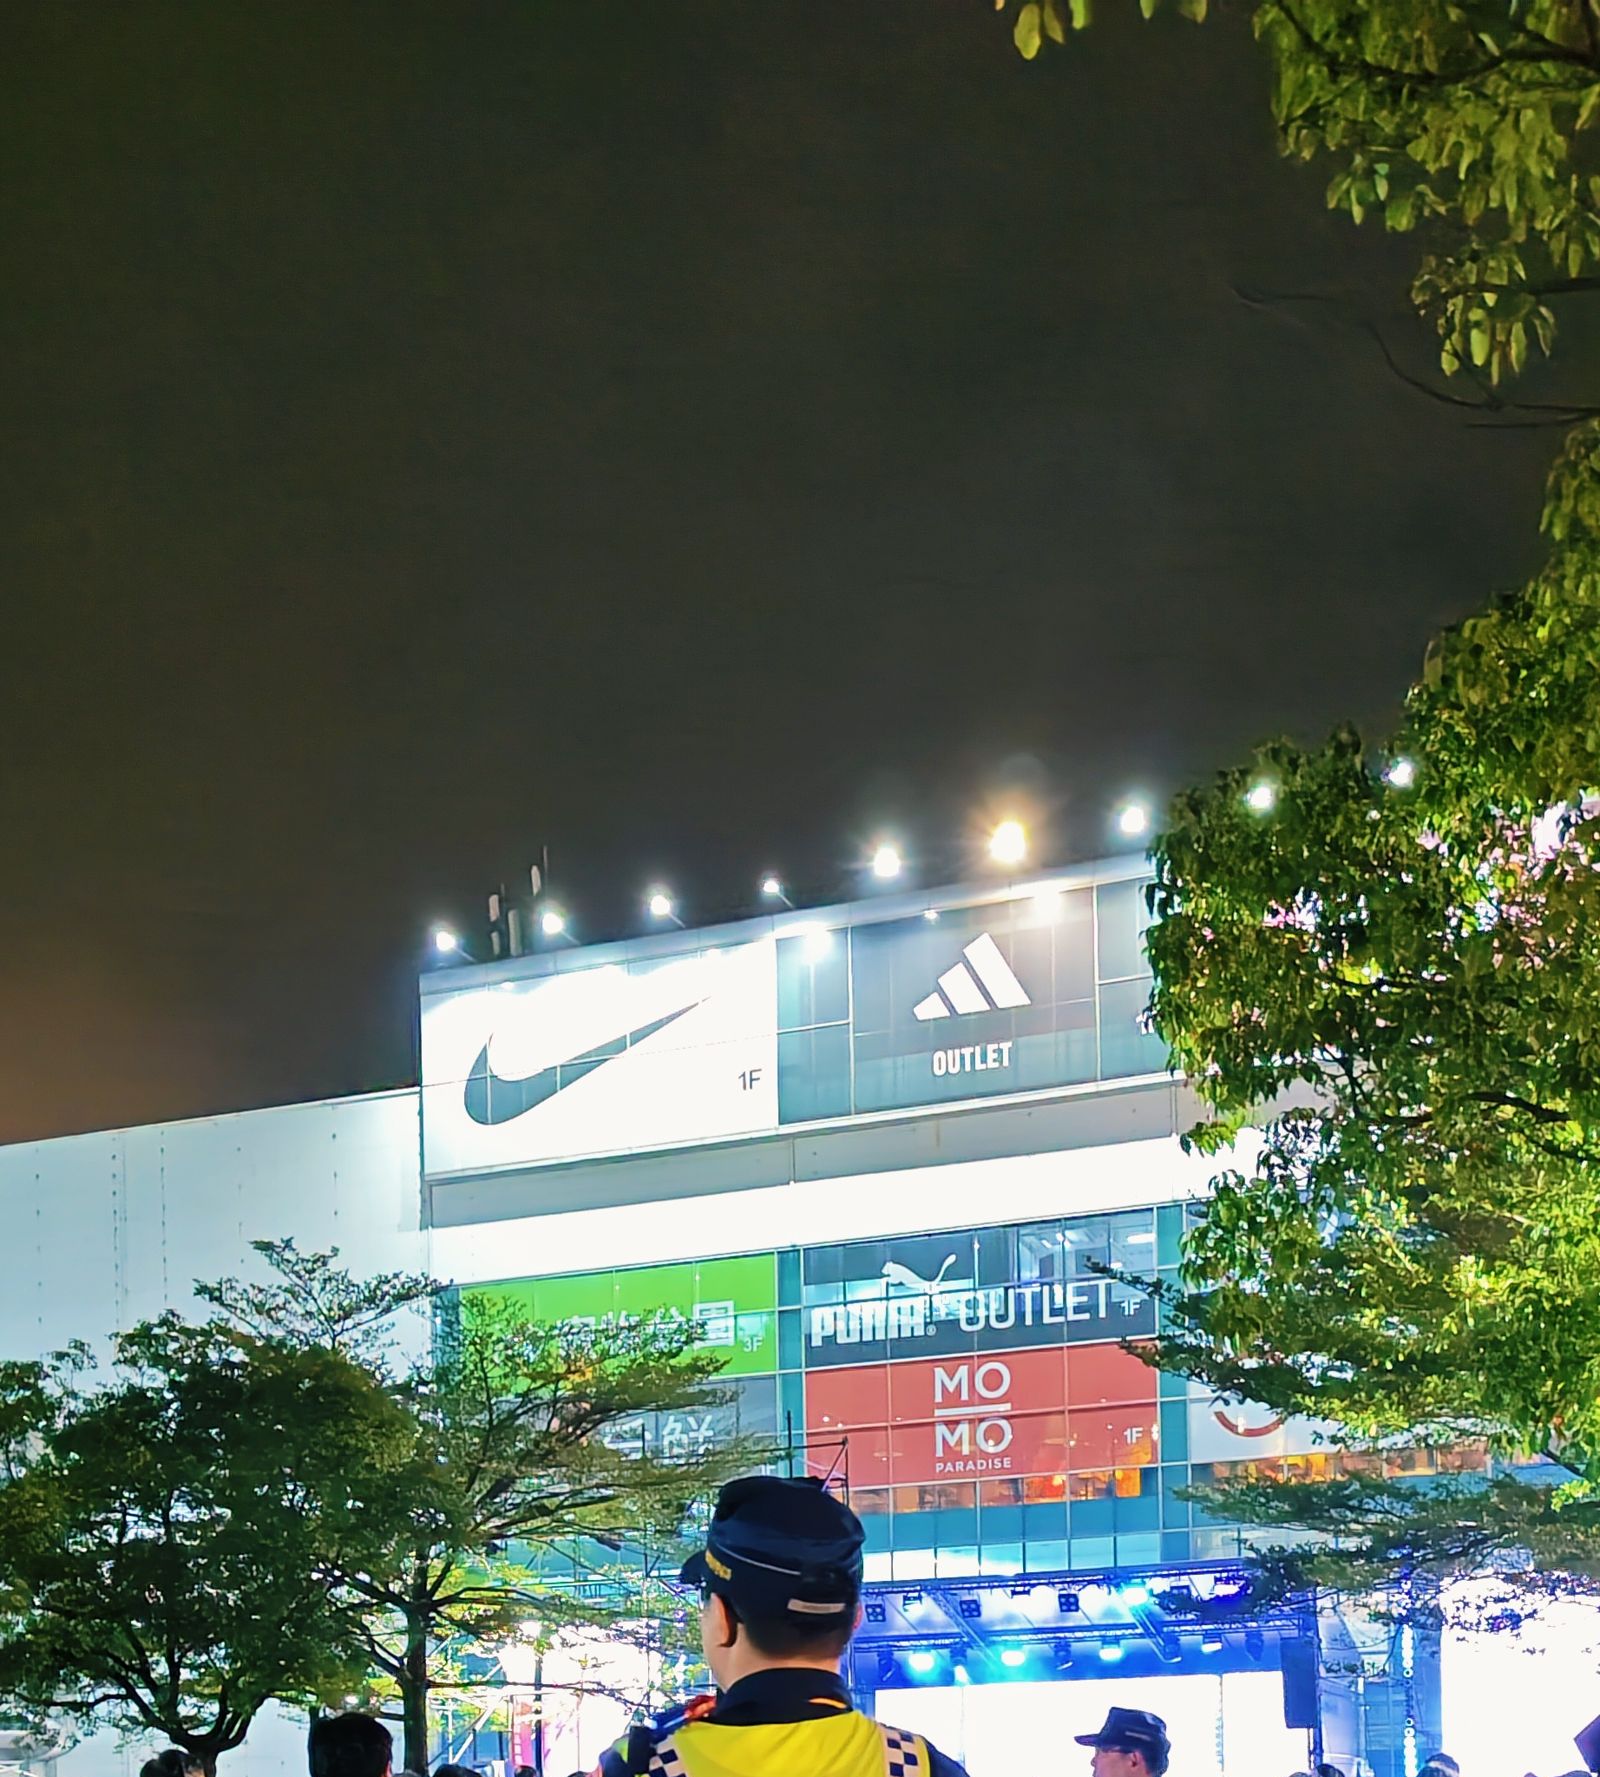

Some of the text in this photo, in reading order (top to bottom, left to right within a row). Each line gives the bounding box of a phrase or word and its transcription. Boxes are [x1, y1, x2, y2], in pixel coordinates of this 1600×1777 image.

[932, 1041, 1012, 1077] OUTLET
[738, 1069, 762, 1091] 1F
[958, 1279, 1118, 1332] OUTLET
[1120, 1299, 1141, 1317] 1F
[743, 1336, 763, 1353] 3F
[934, 1361, 1012, 1403] MO
[935, 1417, 1013, 1457] MO
[1123, 1426, 1143, 1444] 1F
[935, 1457, 1012, 1473] PARADISE
